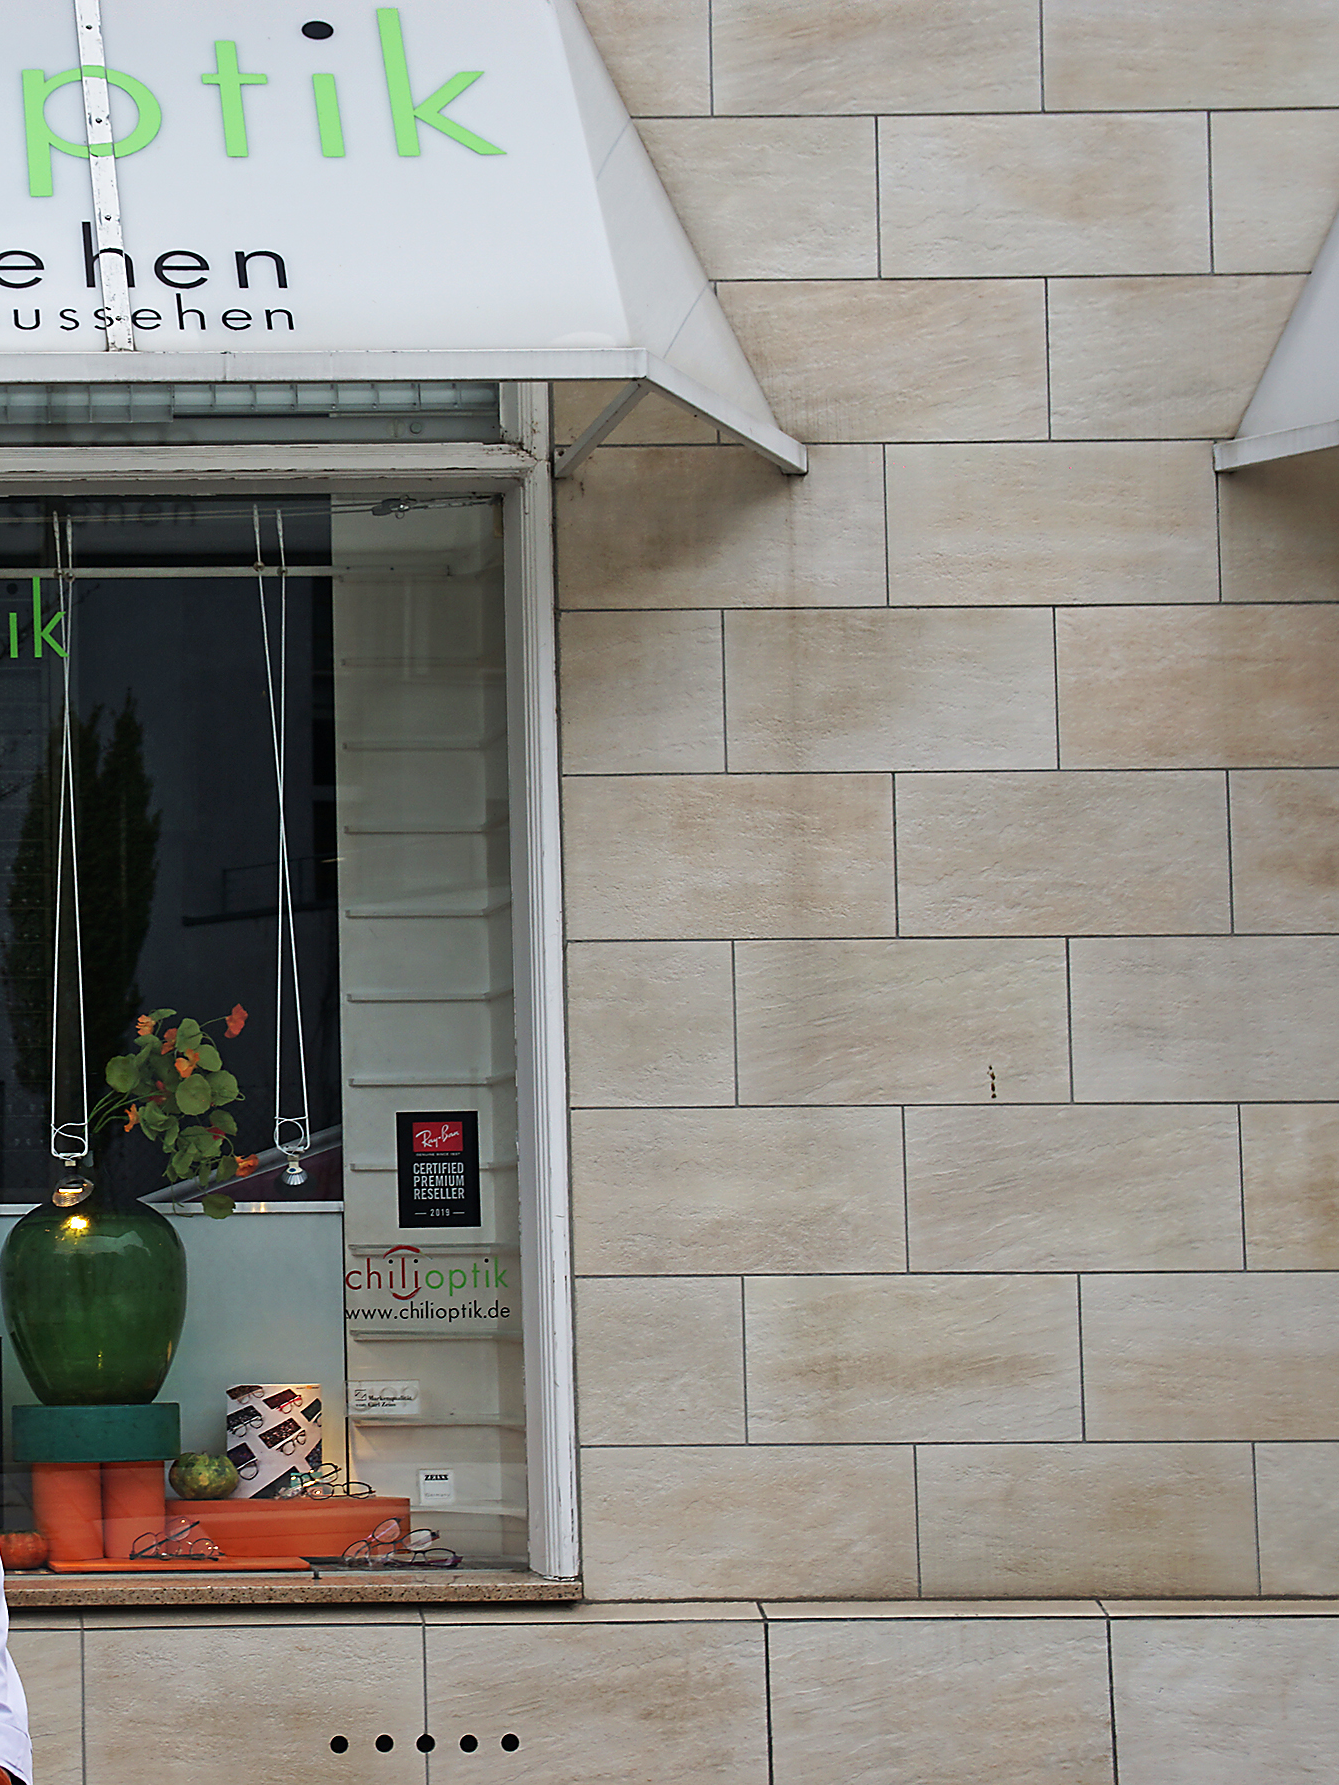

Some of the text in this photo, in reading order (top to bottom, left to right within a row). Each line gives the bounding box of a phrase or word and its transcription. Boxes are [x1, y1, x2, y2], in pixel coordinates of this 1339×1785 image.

[415, 1124, 460, 1148] Ray-Ban
[413, 1162, 464, 1174] CERTIFIED
[413, 1175, 464, 1187] PREMIUM
[414, 1187, 465, 1200] RESELLER
[430, 1208, 450, 1217] 2019
[345, 1256, 509, 1297] chilioptik
[346, 1300, 511, 1323] www.chilioptik.de
